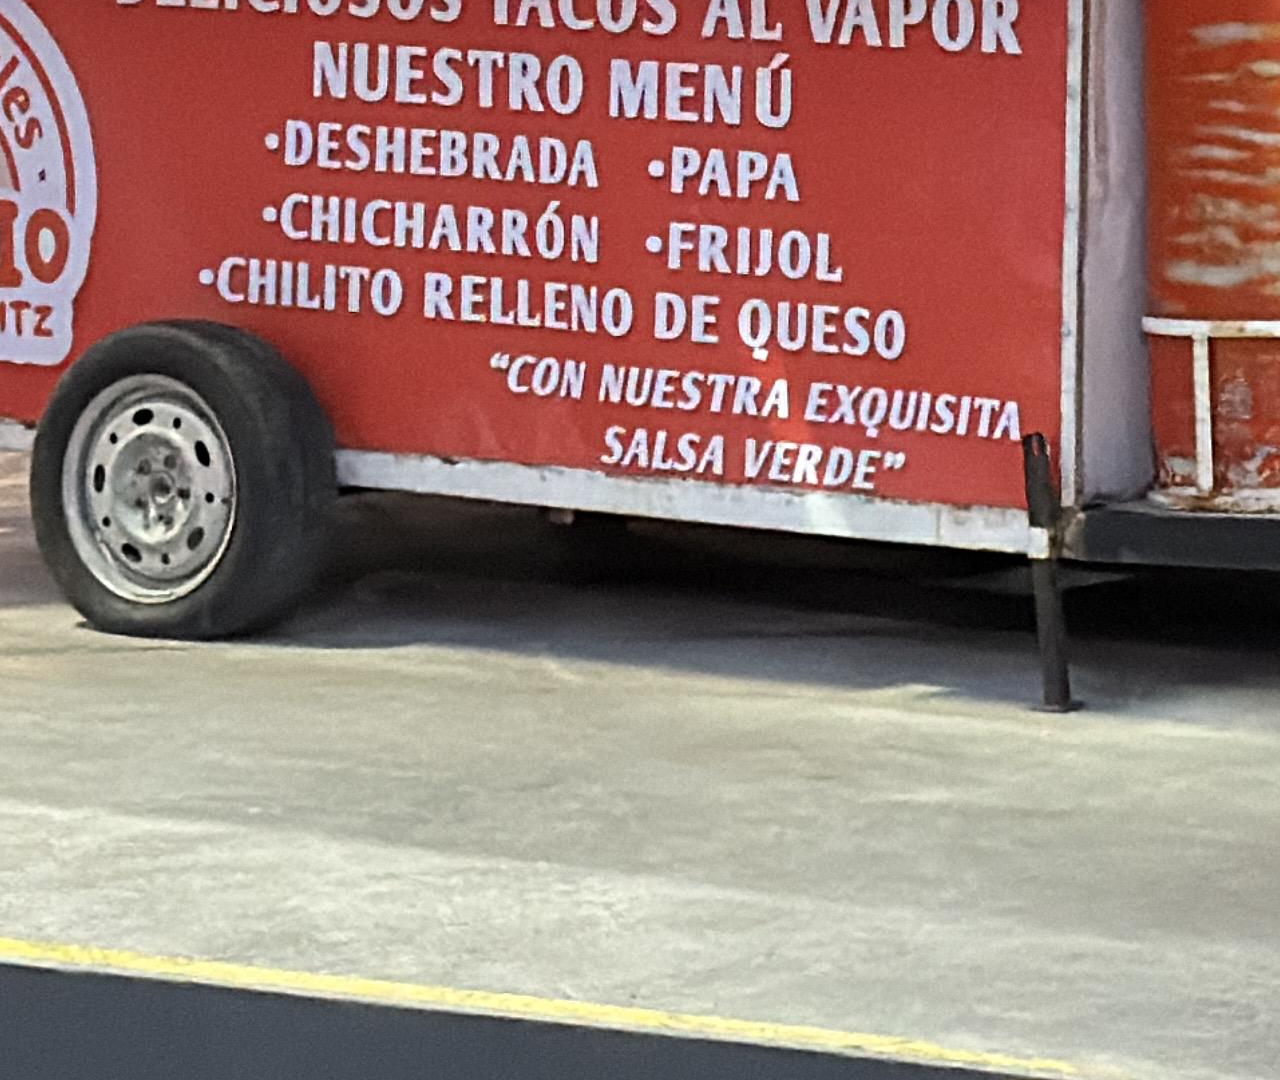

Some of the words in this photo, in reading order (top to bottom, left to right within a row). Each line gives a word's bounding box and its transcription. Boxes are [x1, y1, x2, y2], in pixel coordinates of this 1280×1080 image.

[312, 40, 583, 115] NUESTRO
[608, 52, 792, 128] MENÚ
[284, 119, 599, 189] DESHEBRADA
[670, 145, 800, 201] PAPA
[280, 193, 599, 263] CHICHARRÓN
[667, 221, 842, 282] FRIJOL
[217, 256, 402, 316] CHILITO
[424, 272, 633, 338] RELLENO
[654, 291, 720, 345] DE
[738, 298, 906, 360] QUESO
[598, 363, 789, 420] NUESTRA
[804, 383, 1021, 441] EXQUISITA
[600, 425, 724, 475] SALSA
